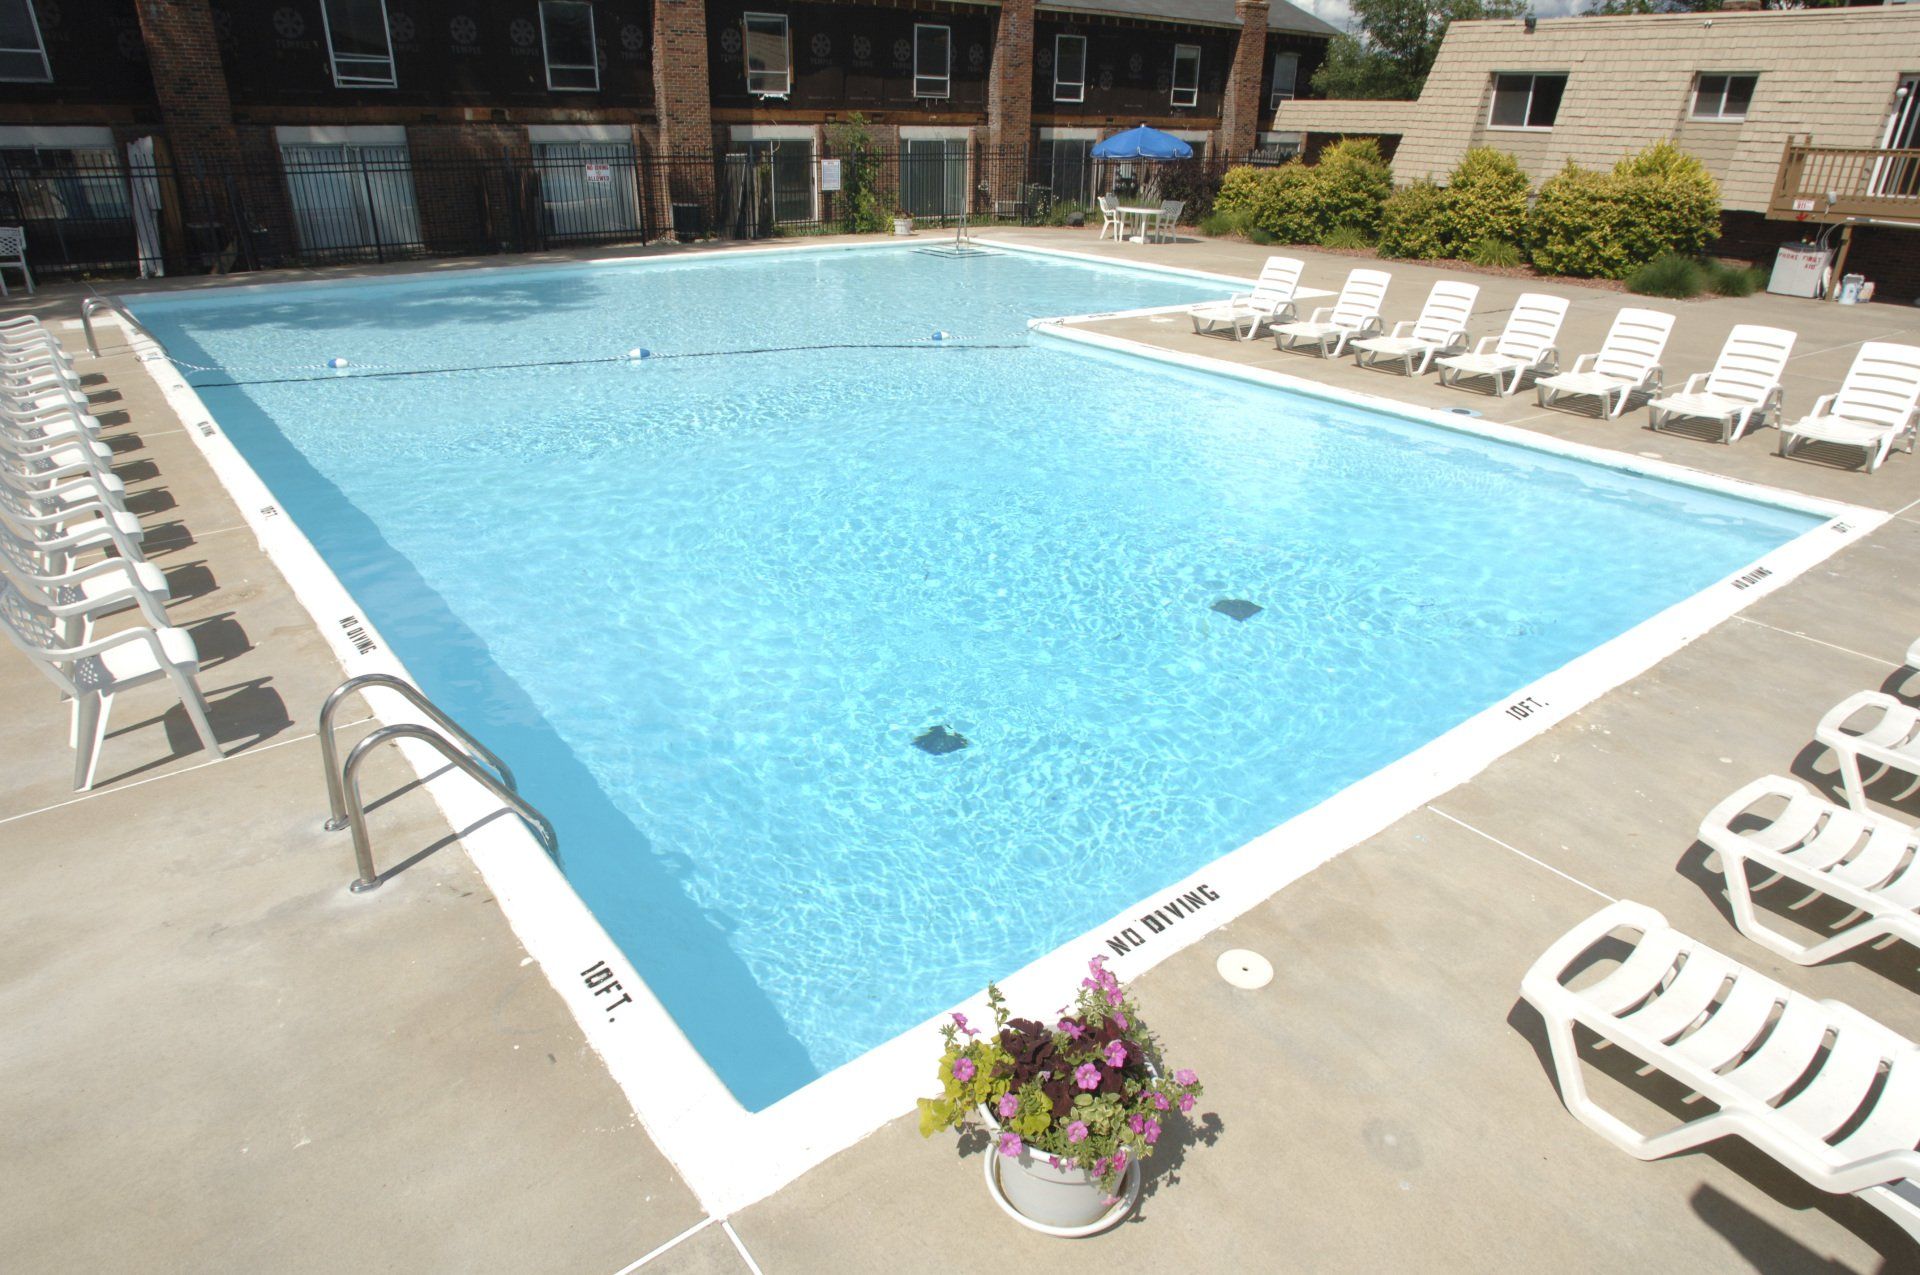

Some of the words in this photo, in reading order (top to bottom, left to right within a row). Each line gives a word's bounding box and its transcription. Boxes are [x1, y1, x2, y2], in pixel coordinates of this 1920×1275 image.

[450, 45, 481, 55] TEMPLE
[510, 47, 540, 57] TEMPLE
[1731, 579, 1749, 590] NO
[1741, 566, 1773, 584] DIVING
[339, 615, 359, 629] NO
[346, 627, 377, 655] DIVING
[1505, 697, 1549, 720] 10FT.
[1105, 927, 1146, 956] NO
[1140, 884, 1220, 934] DIVING
[580, 960, 632, 1023] 10FT.
